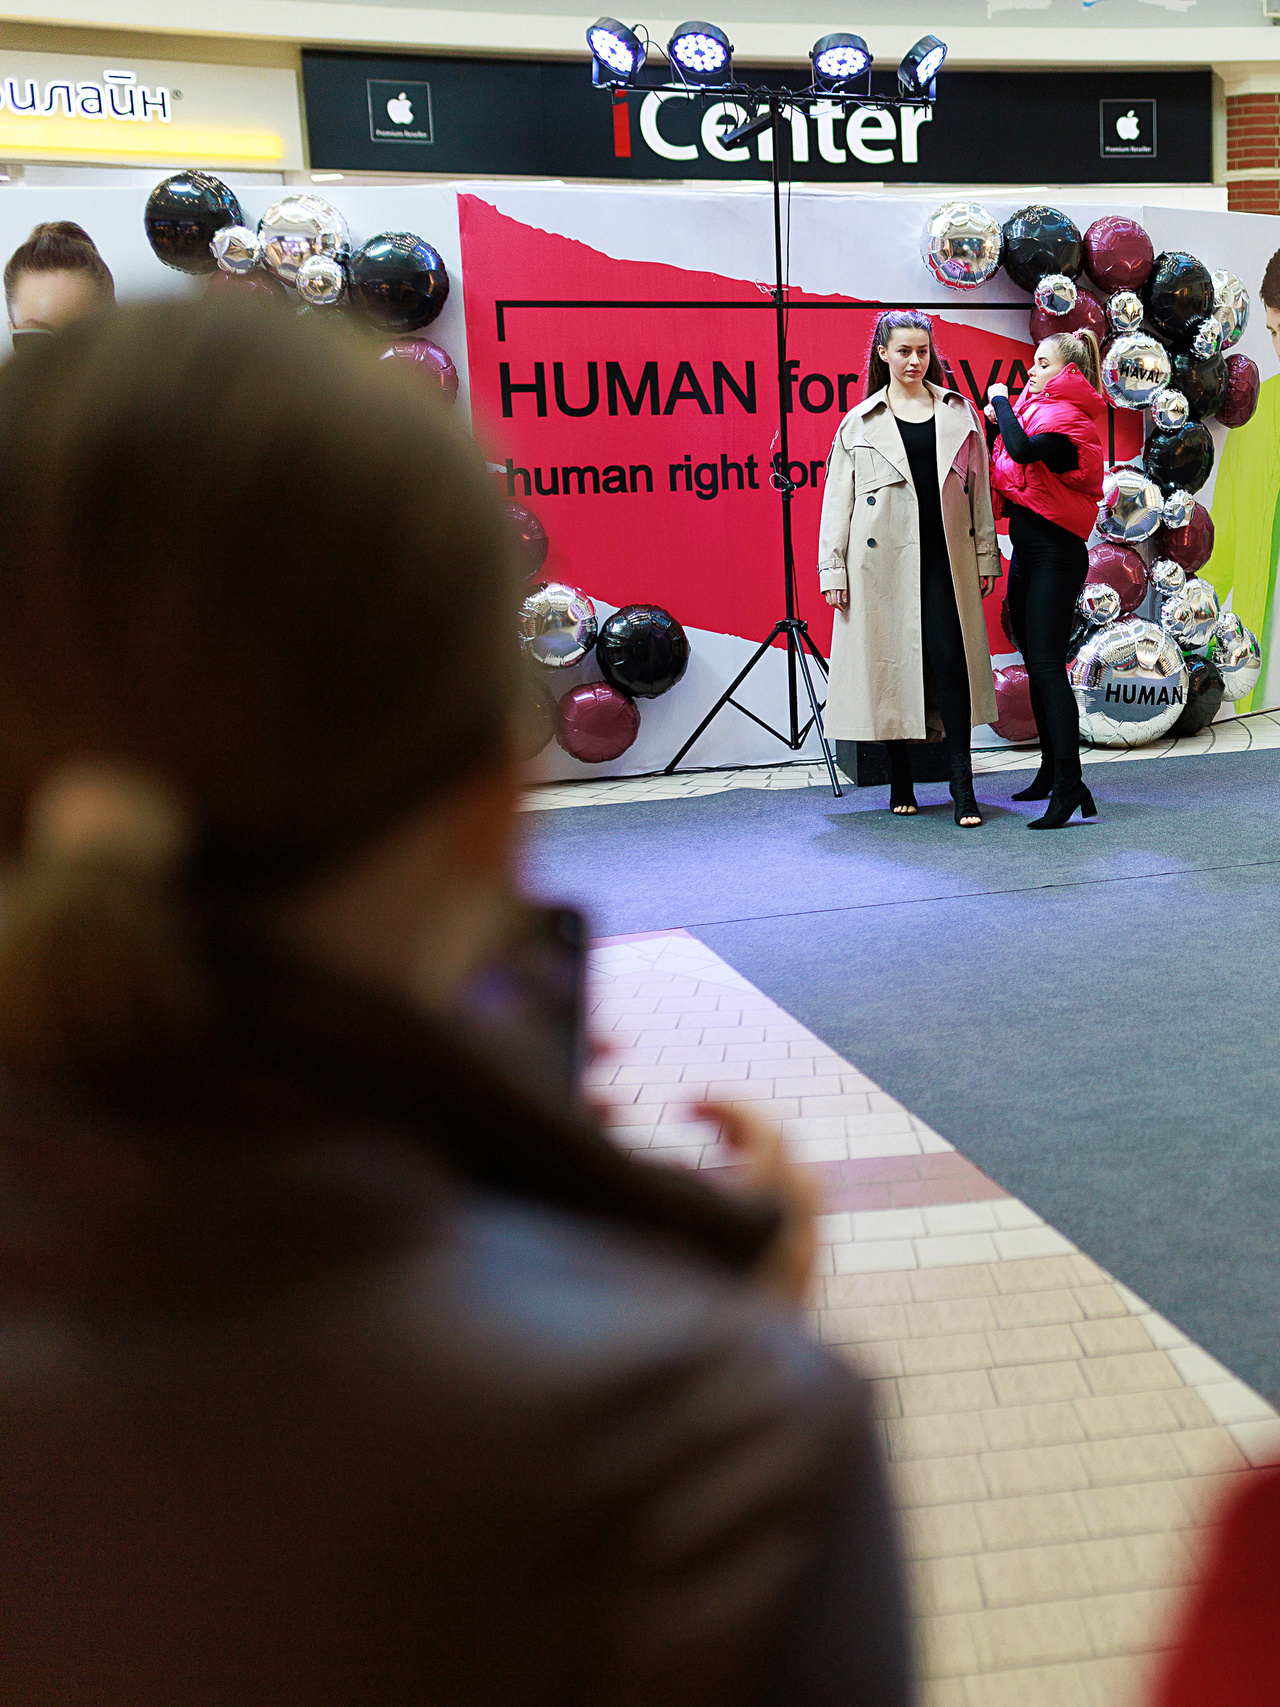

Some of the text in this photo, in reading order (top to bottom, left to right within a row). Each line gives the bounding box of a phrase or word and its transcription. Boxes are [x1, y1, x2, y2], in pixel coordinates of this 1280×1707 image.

[0, 69, 172, 124] илайн
[612, 83, 933, 164] iCenter
[499, 360, 756, 418] HUMAN
[785, 357, 858, 414] for
[1119, 364, 1161, 384] HAVAL
[506, 451, 825, 501] human right for
[1105, 683, 1183, 706] HUMAN
